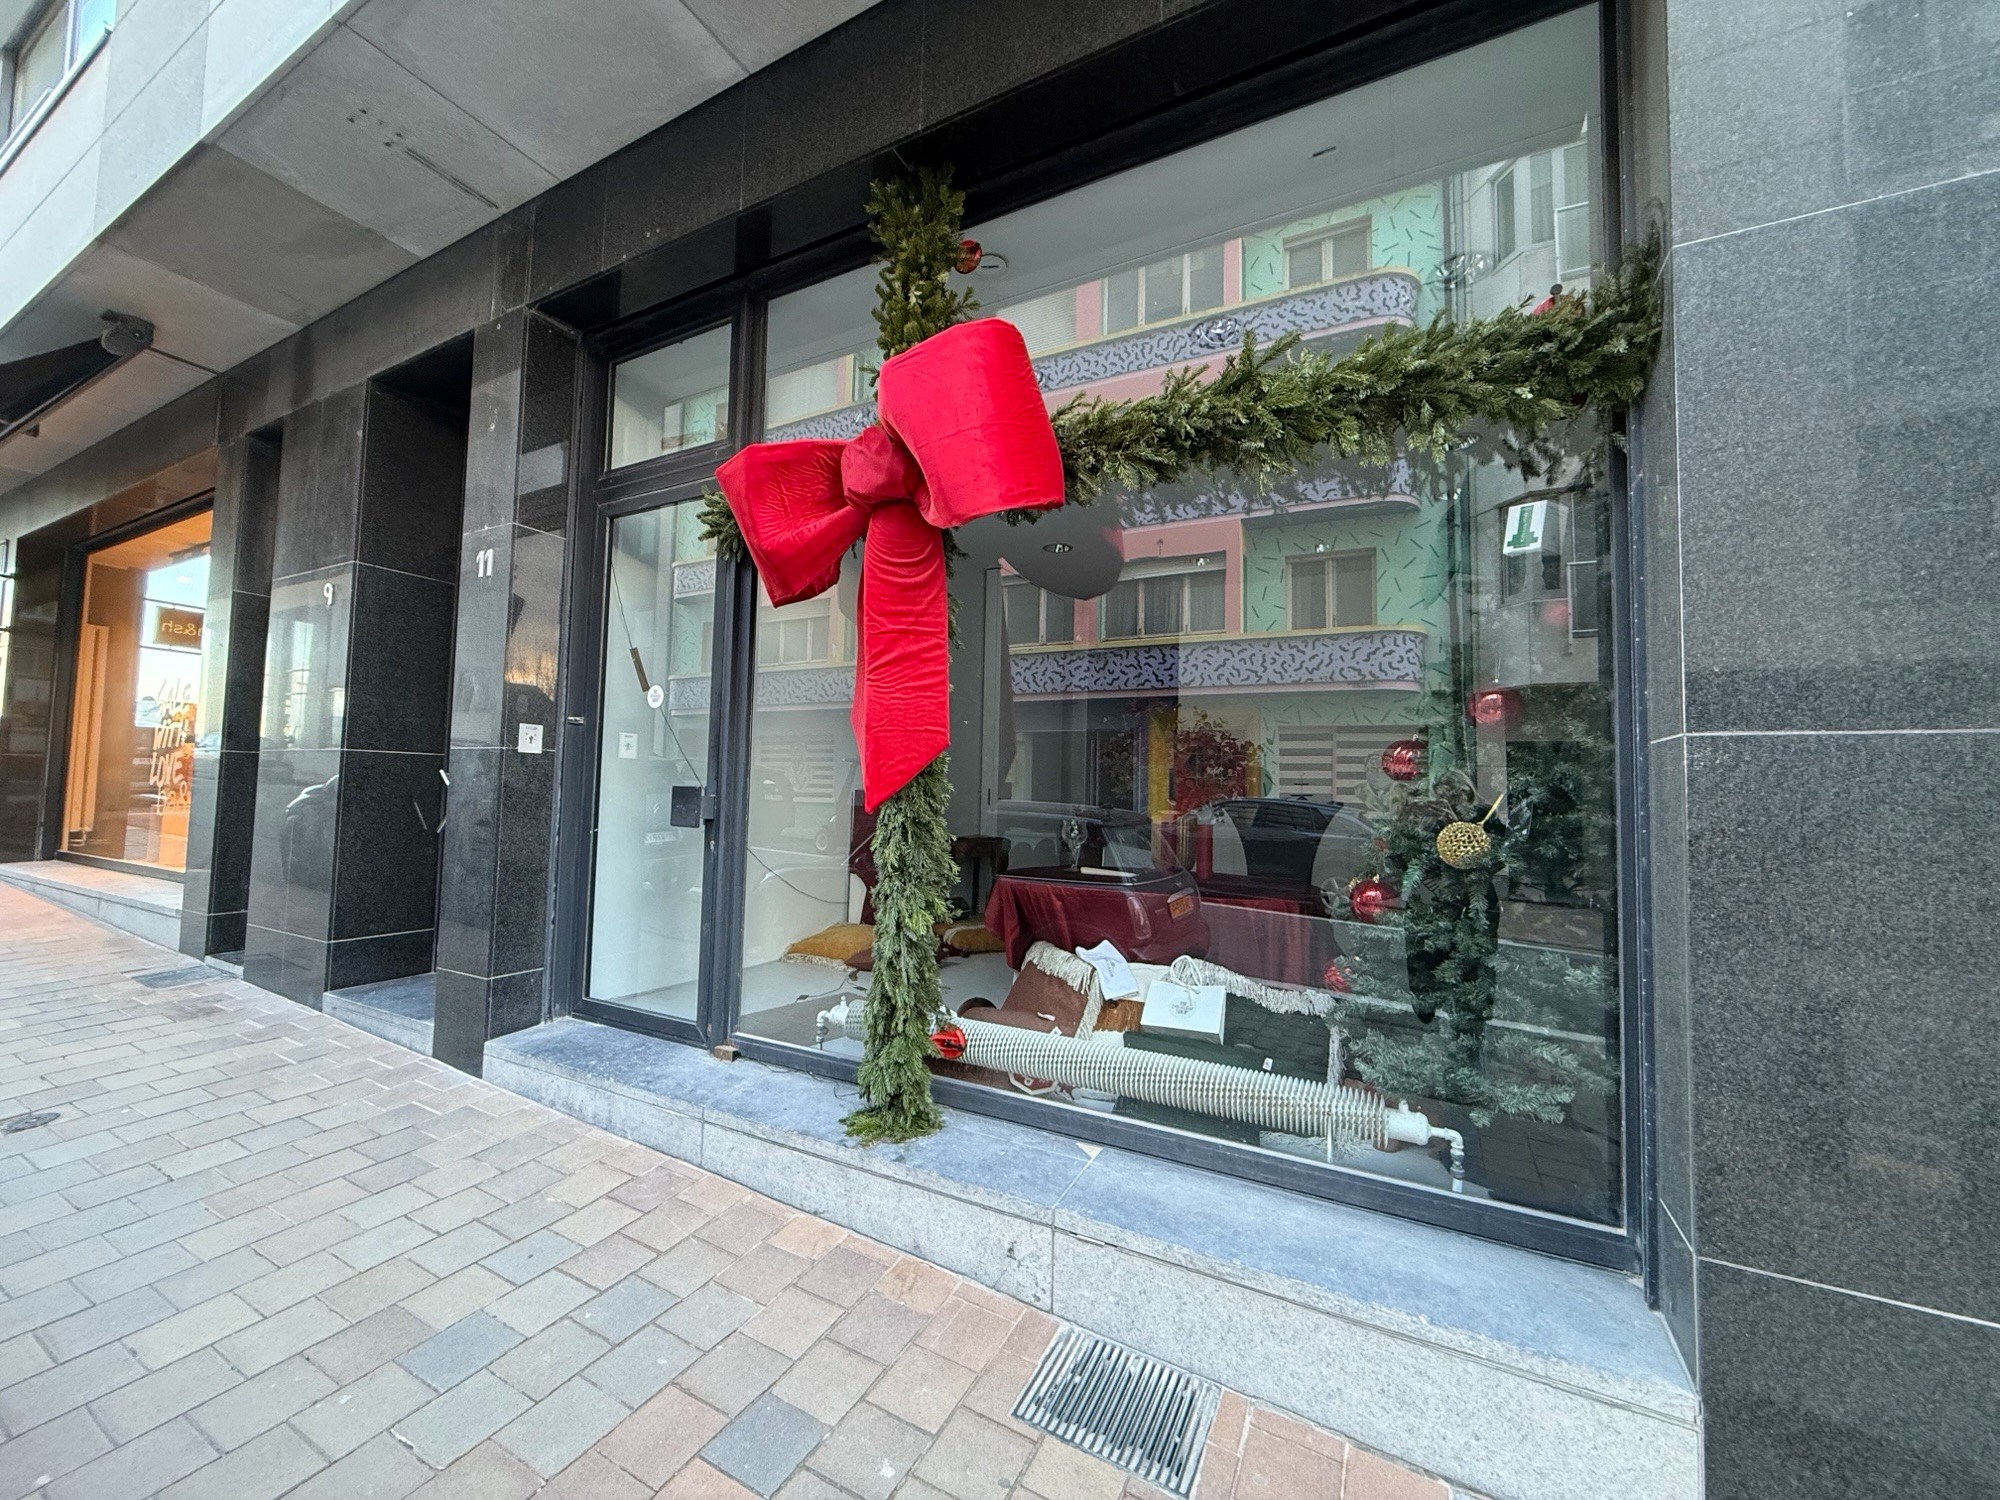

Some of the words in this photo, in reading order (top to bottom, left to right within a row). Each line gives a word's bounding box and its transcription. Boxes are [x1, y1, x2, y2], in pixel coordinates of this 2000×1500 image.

[475, 548, 494, 578] 11
[323, 582, 334, 606] 9
[153, 718, 188, 751] WITH
[149, 751, 185, 788] LOVE
